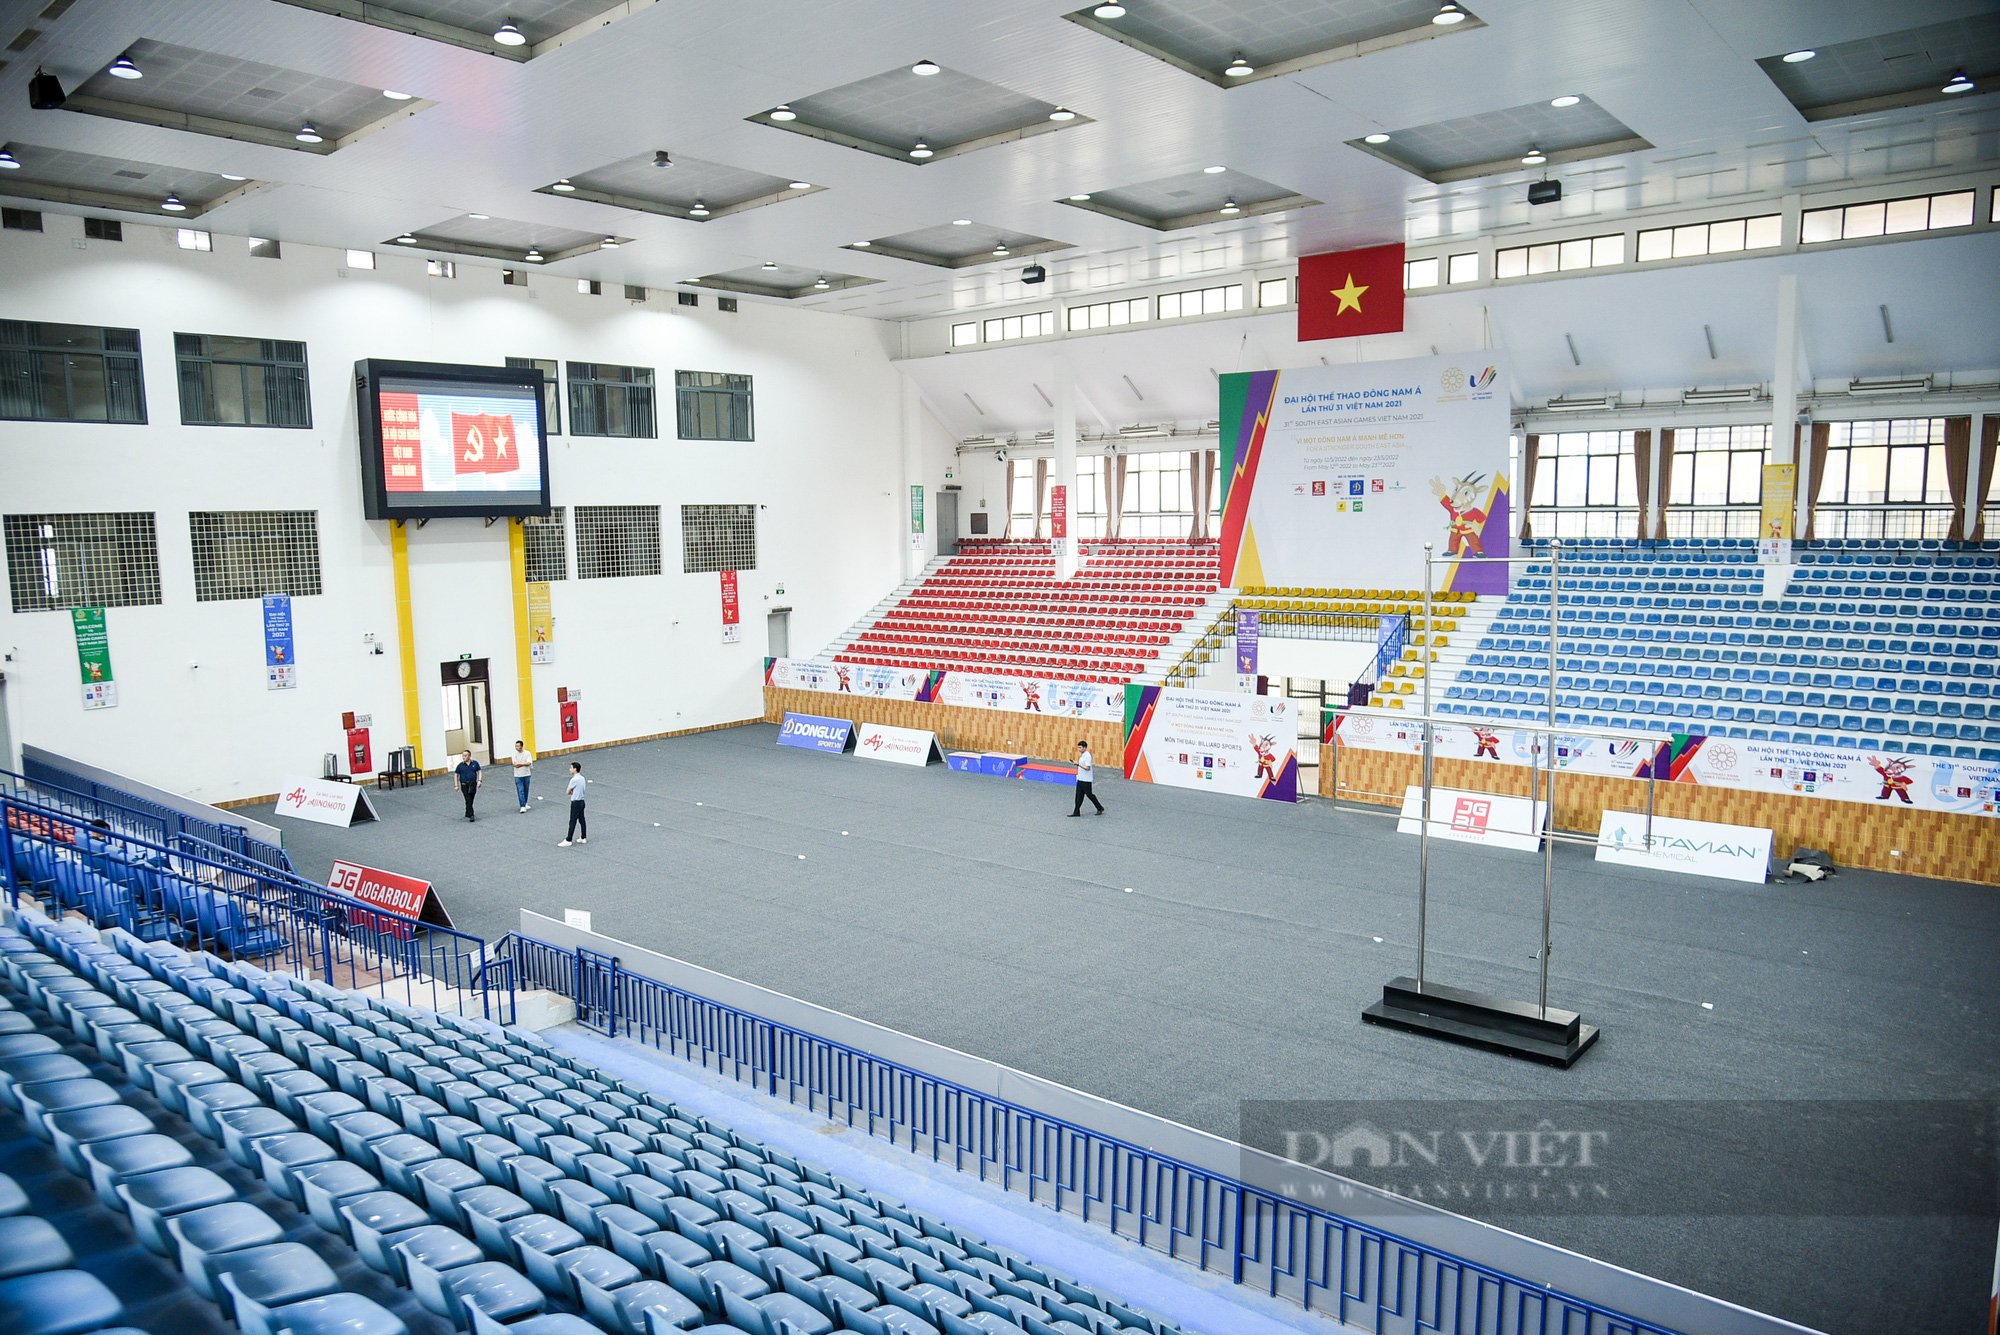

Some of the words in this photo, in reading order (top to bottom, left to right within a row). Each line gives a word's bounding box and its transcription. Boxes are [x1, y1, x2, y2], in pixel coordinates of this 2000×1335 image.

[1284, 396, 1298, 404] ĐẠI
[1301, 394, 1316, 403] HỘI
[1337, 391, 1360, 400] THAO
[1363, 388, 1389, 398] ĐÔNG
[1392, 387, 1412, 396] NAM
[1365, 401, 1383, 409] NAM
[1385, 400, 1402, 408] 2021
[1295, 419, 1316, 427] SOUTH
[794, 723, 846, 740] DONGLUC
[1791, 749, 1811, 758] THAO
[307, 799, 346, 811] AJINOMOTO
[1642, 834, 1756, 858] STAVIAN
[330, 869, 358, 892] JG
[357, 881, 421, 912] JOGARBOLA
